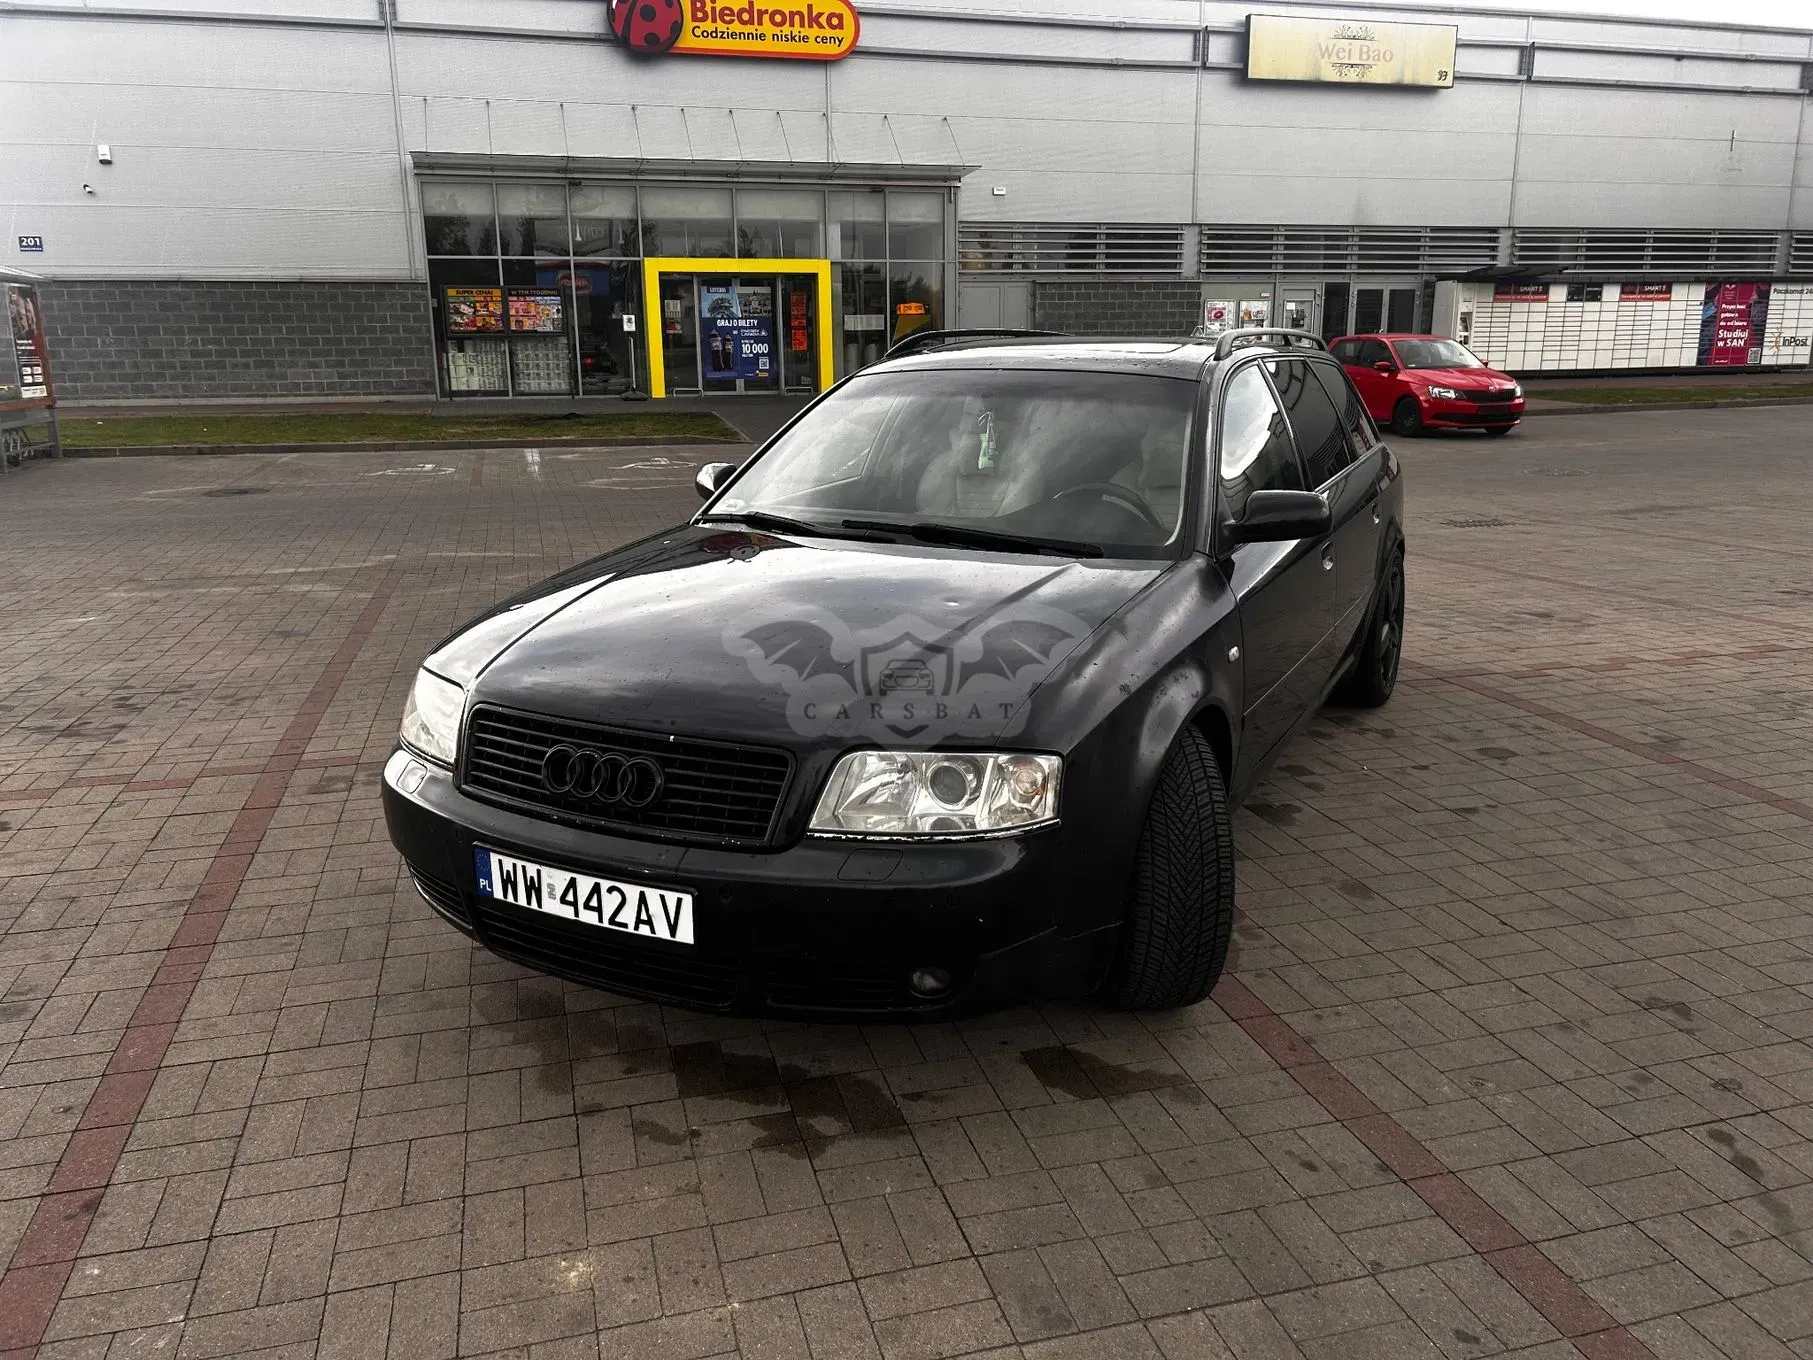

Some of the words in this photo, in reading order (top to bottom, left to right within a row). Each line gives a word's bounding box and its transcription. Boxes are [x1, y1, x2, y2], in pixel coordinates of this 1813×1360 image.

[691, 0, 844, 30] Biedronka
[691, 26, 767, 42] Codziennie
[772, 30, 809, 44] niskie
[815, 35, 844, 47] ceny
[1318, 42, 1353, 62] Wei
[1358, 45, 1394, 62] Bao
[21, 237, 40, 246] 201
[1718, 329, 1748, 338] Studiuj
[742, 344, 750, 353] 10
[752, 344, 768, 353] 000
[1782, 337, 1808, 346] InPost
[479, 878, 492, 892] PL
[498, 858, 543, 910] WW
[559, 876, 684, 939] 442AV
